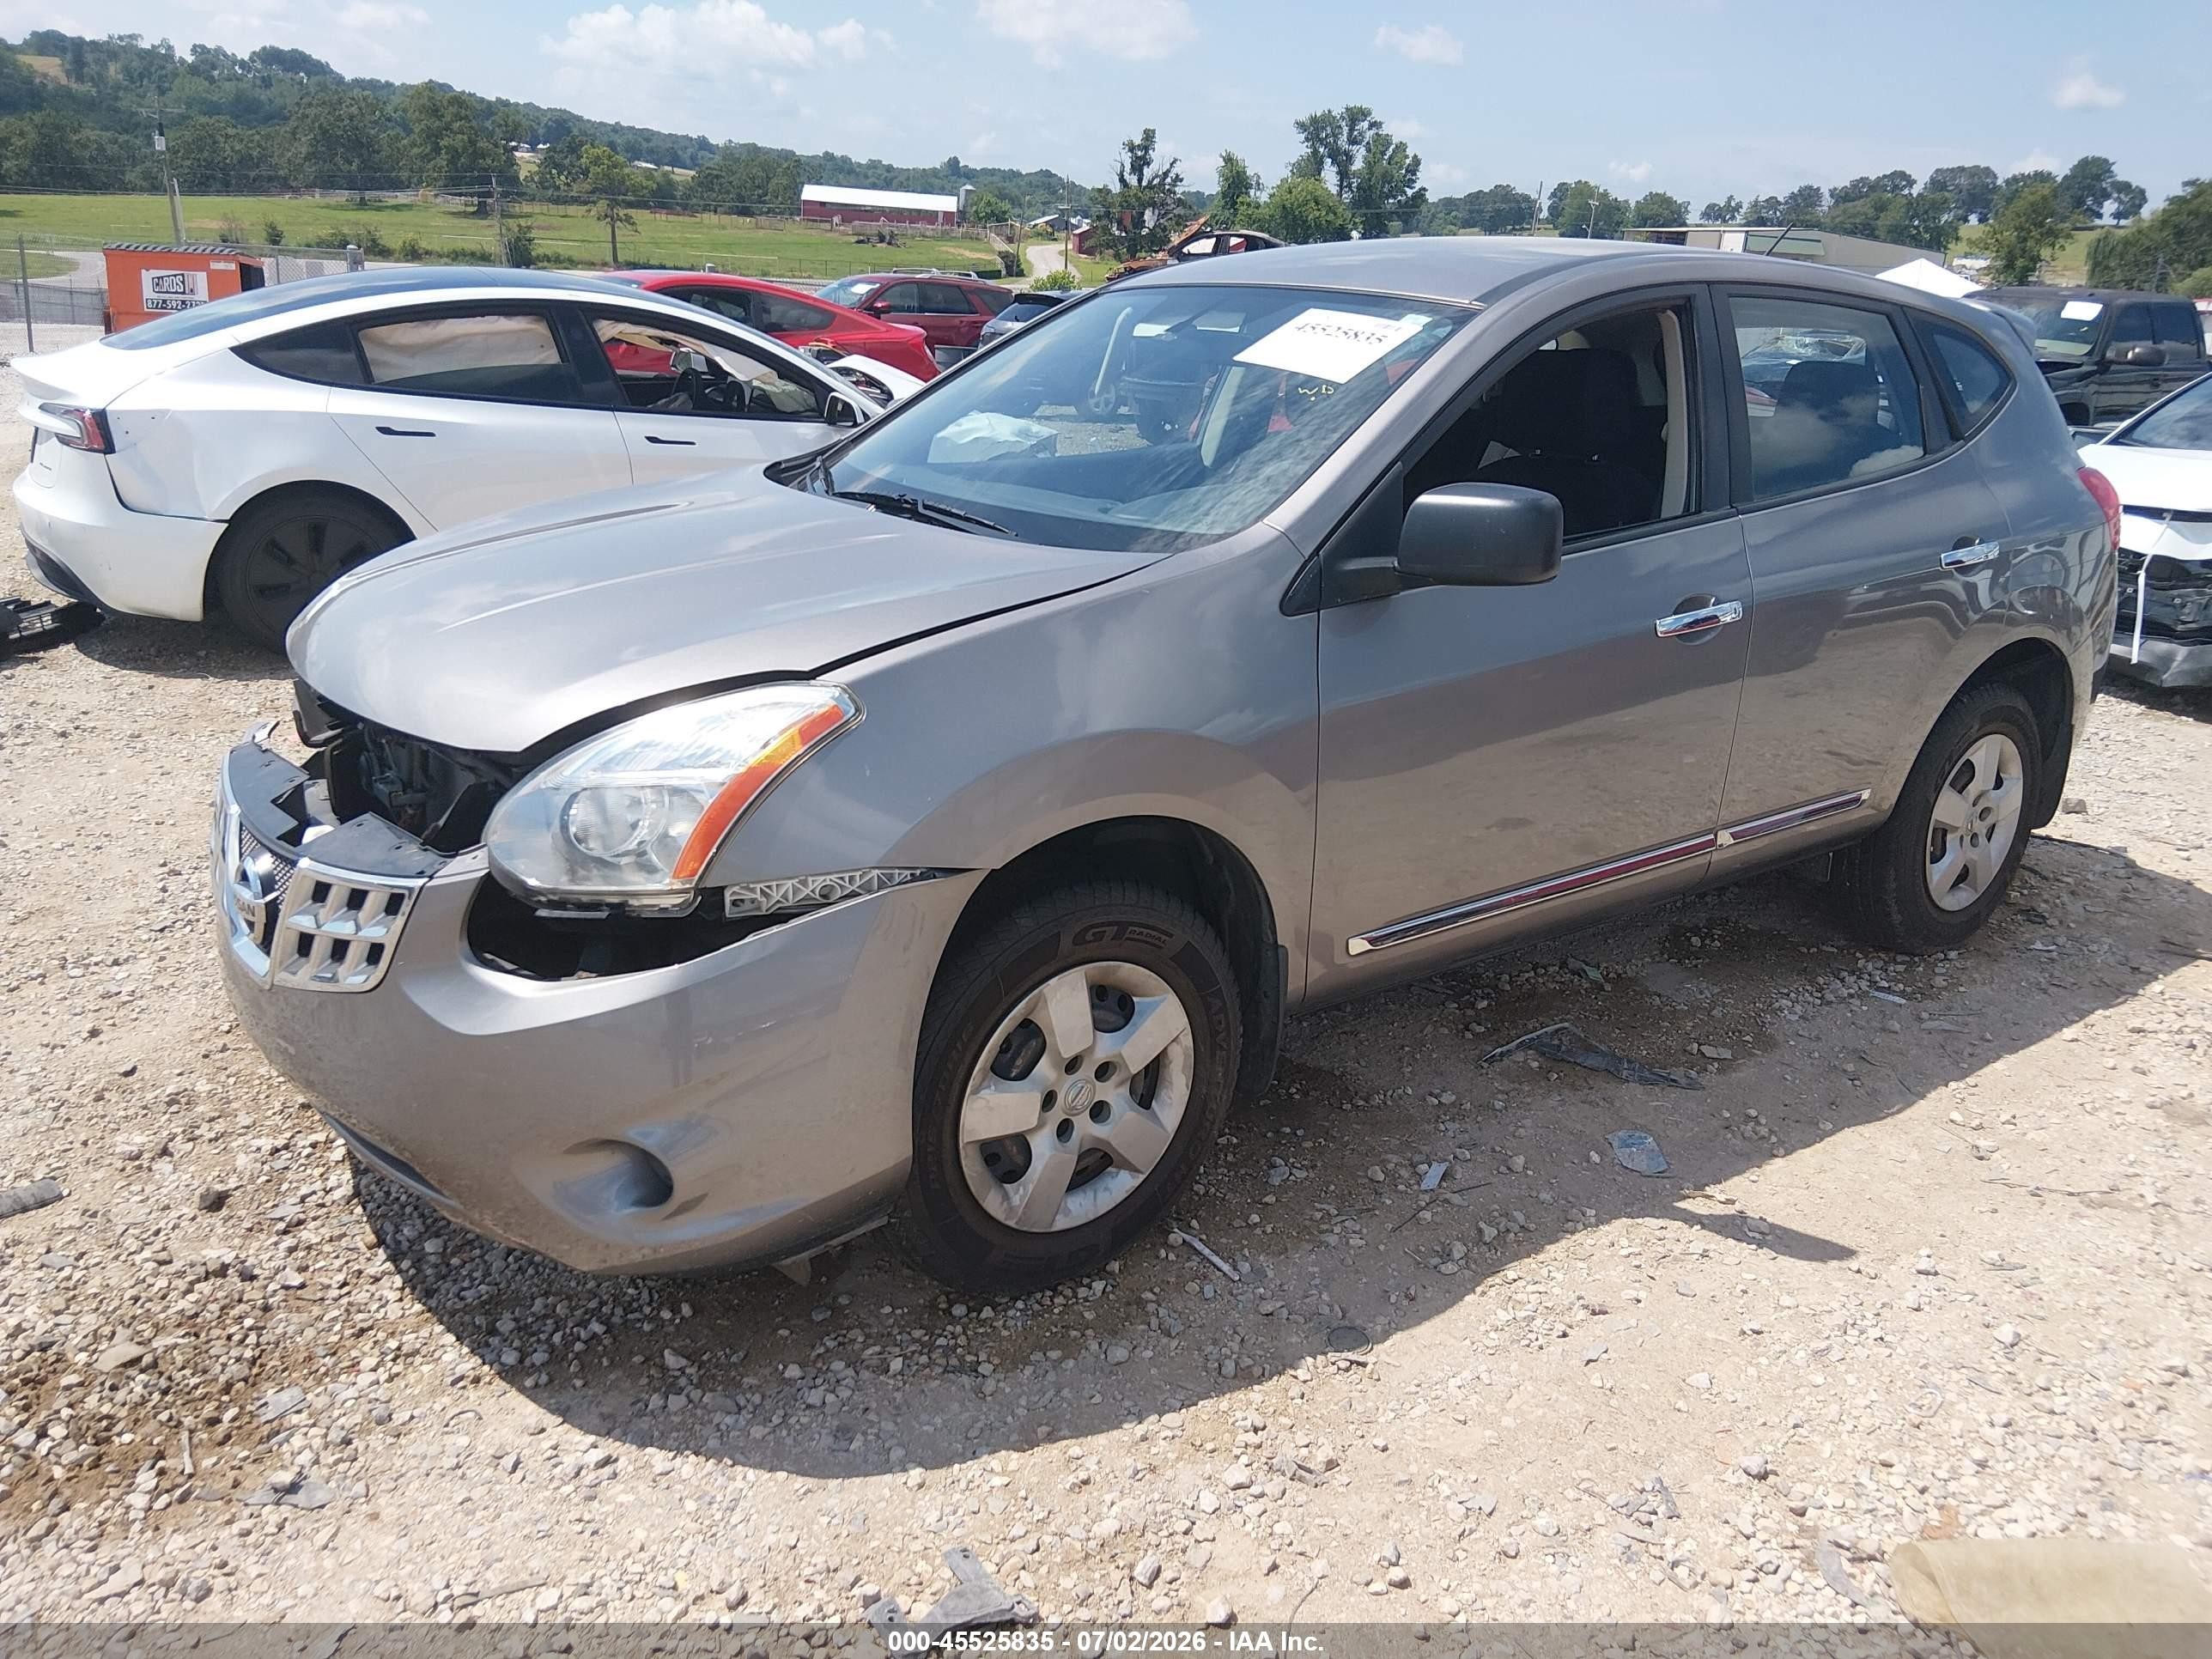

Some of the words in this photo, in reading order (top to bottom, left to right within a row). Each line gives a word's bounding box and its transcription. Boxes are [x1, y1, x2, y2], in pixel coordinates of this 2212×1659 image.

[153, 276, 184, 292] CARDS
[147, 299, 204, 309] 877-592-27
[1128, 927, 1168, 945] RADIAL
